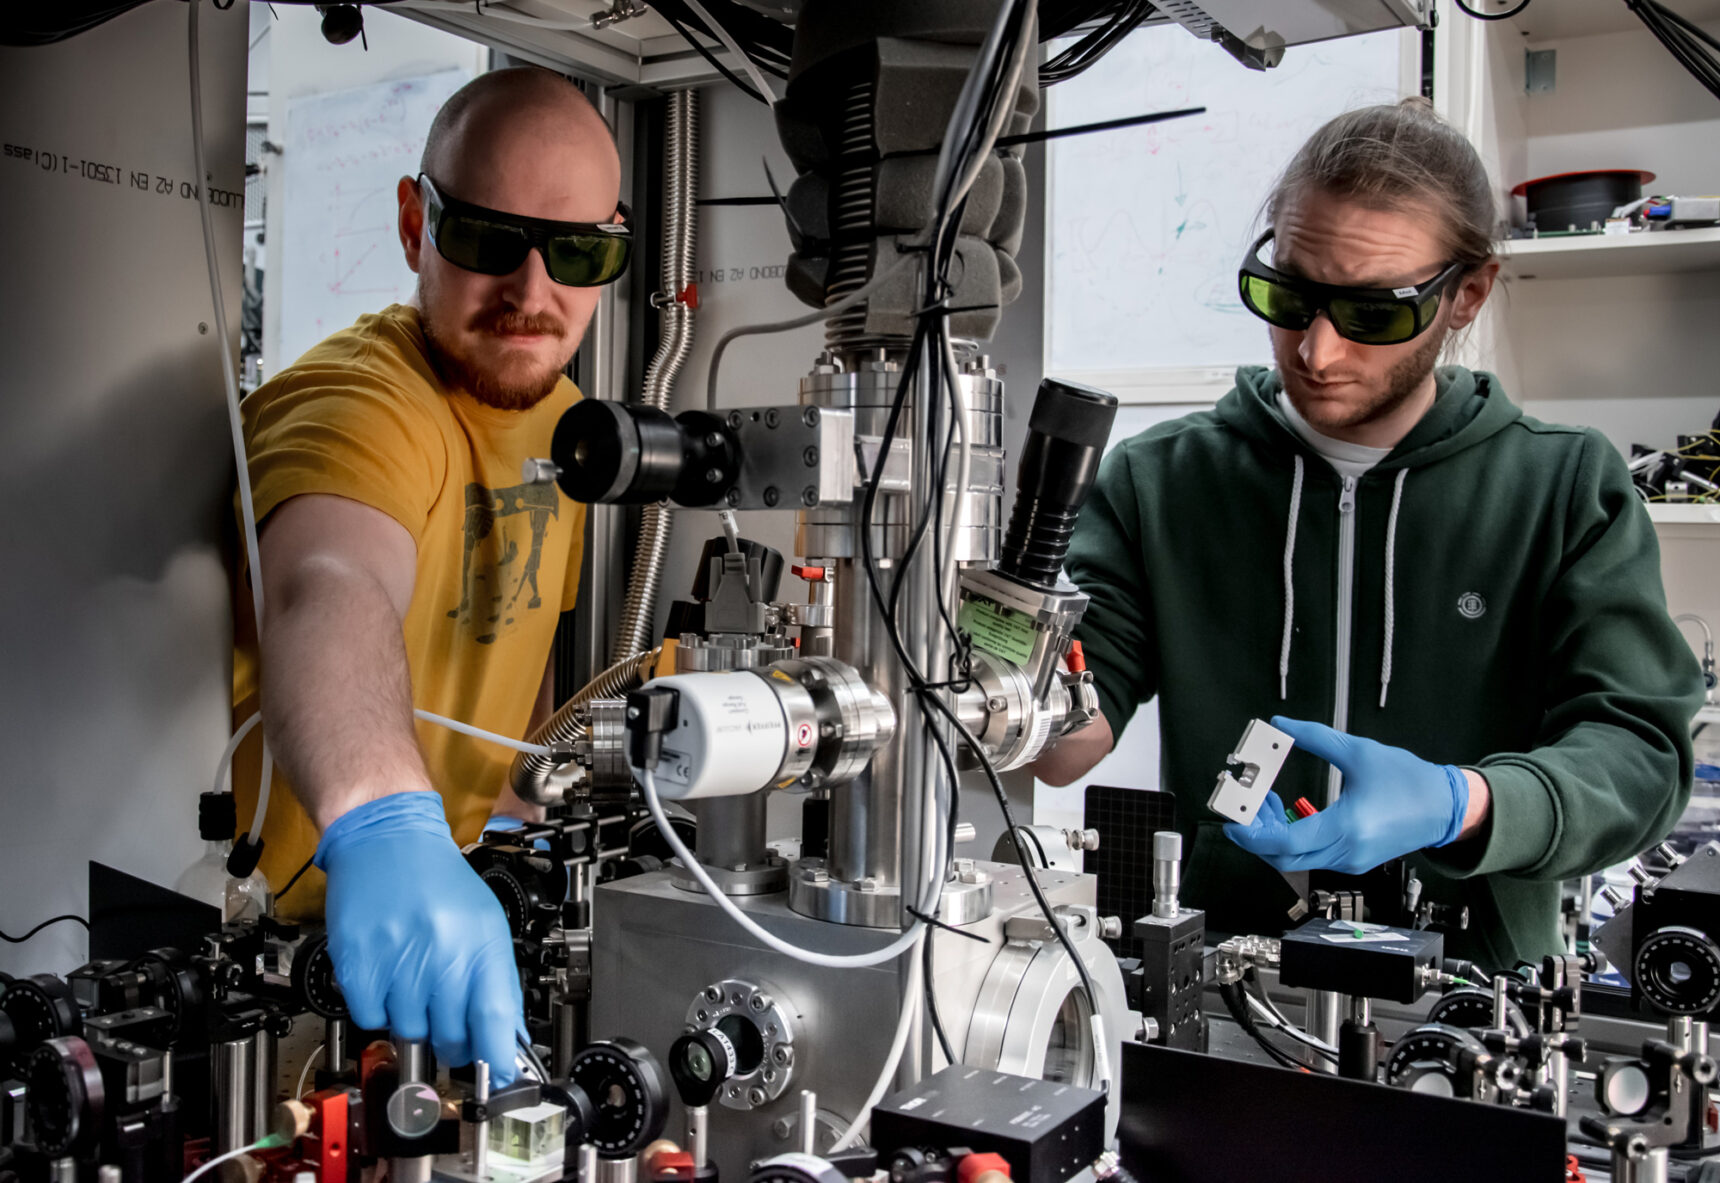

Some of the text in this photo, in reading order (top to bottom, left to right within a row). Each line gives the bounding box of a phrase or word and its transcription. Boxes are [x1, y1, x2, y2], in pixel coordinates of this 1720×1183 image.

[130, 171, 149, 191] EN
[156, 176, 174, 195] A2
[180, 182, 245, 209] LUCOBND
[710, 269, 725, 283] EN
[730, 267, 744, 281] A2
[749, 264, 786, 280] OBOND
